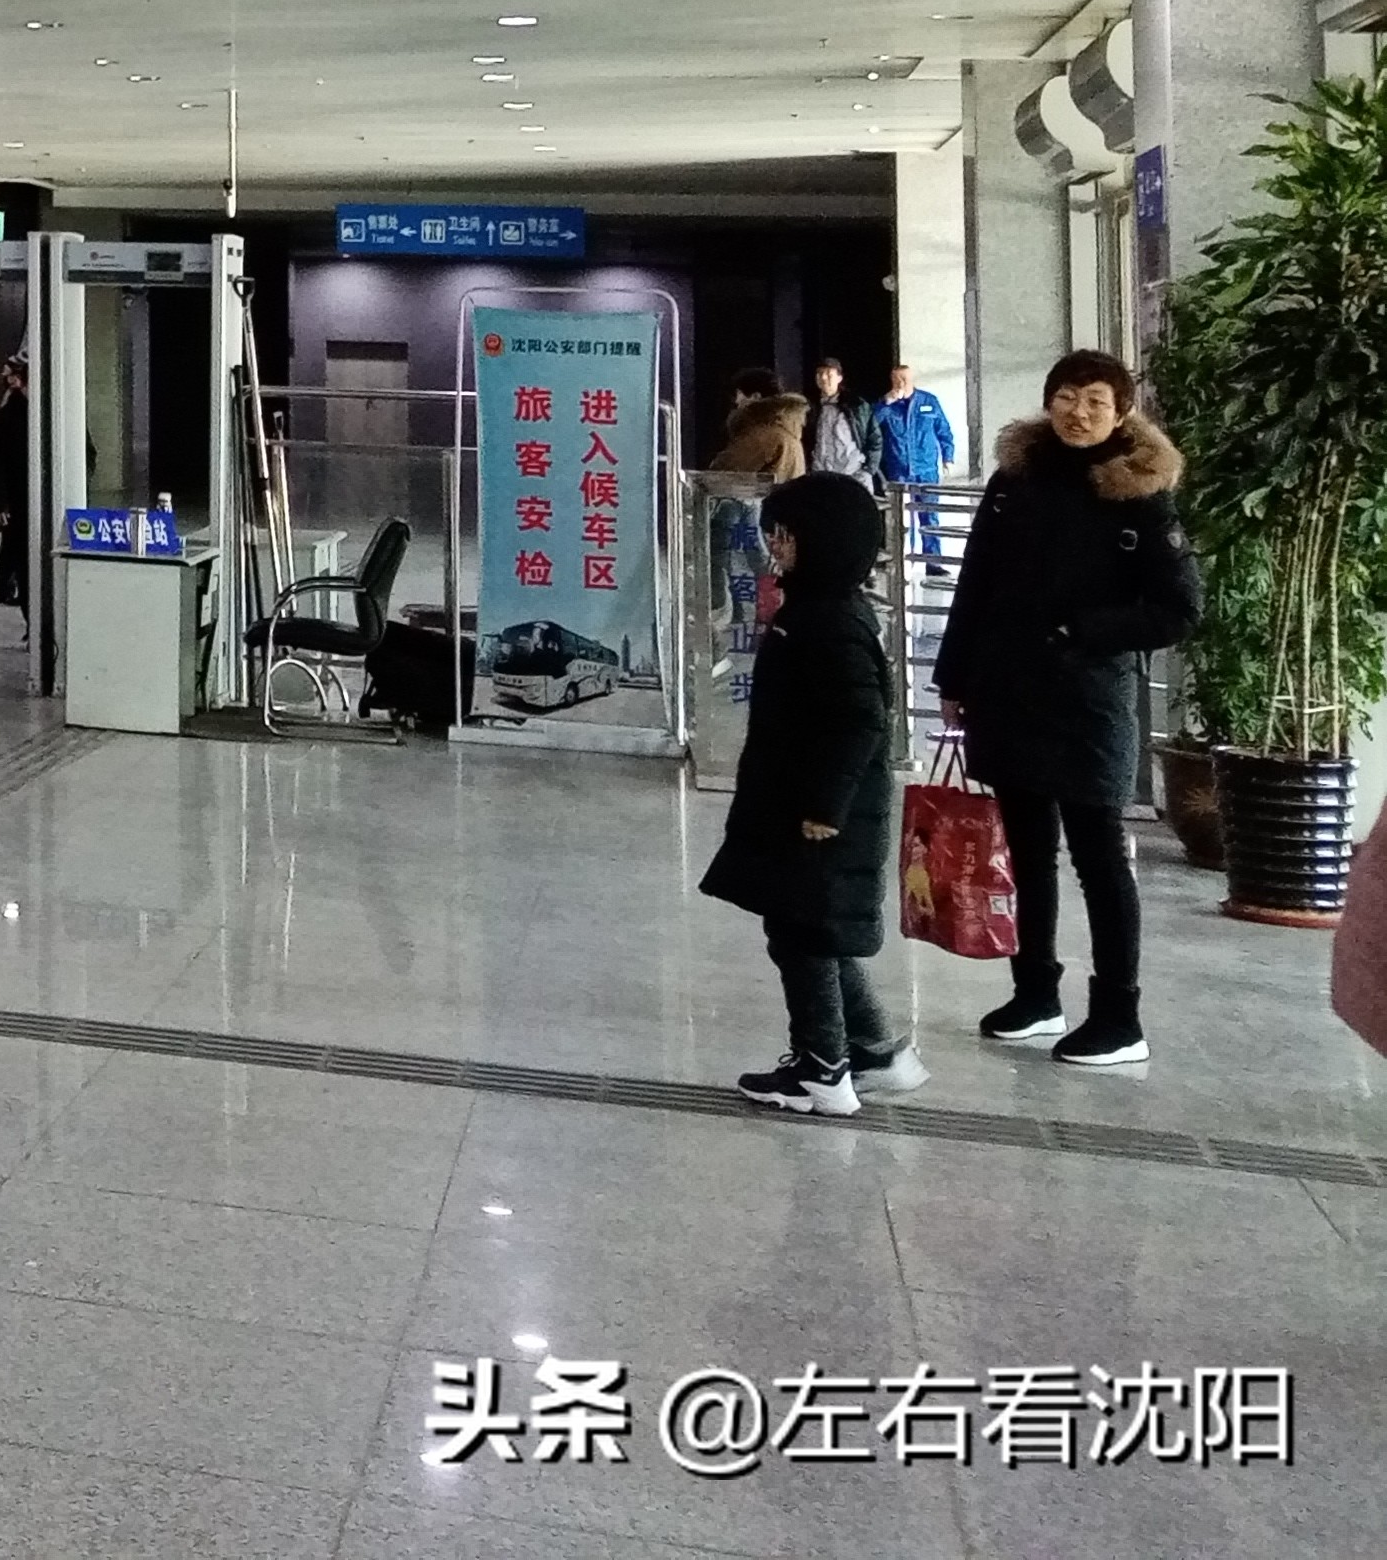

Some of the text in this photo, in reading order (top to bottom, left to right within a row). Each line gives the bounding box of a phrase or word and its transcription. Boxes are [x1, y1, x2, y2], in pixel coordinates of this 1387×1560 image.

[367, 214, 399, 231] 售票处
[448, 215, 481, 232] 卫生间
[527, 217, 560, 234] 警务室
[511, 338, 642, 356] 沈阳公安部门提醒
[514, 386, 553, 587] 旅客安检
[580, 389, 619, 590] 进入候车区
[98, 518, 169, 546] 公安站
